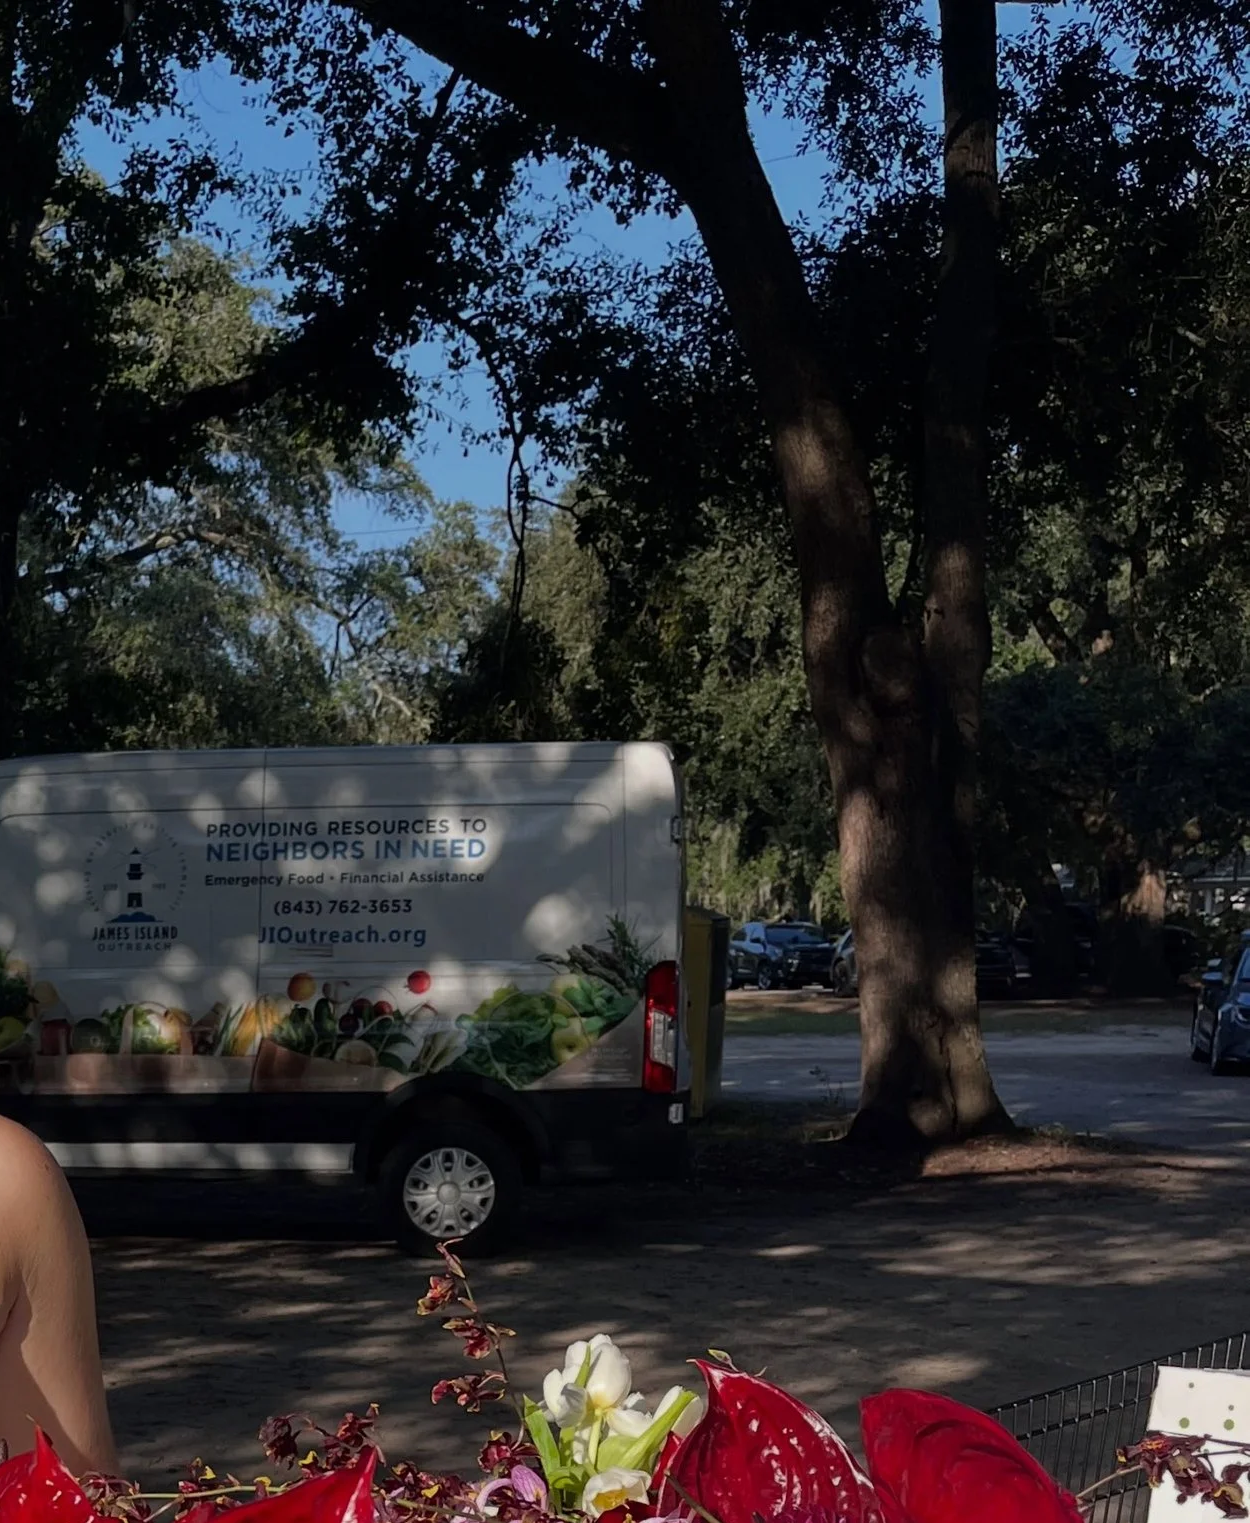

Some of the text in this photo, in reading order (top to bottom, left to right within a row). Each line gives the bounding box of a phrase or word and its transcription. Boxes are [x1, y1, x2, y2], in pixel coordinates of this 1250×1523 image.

[206, 818, 487, 838] PROVIDING RESOURCES TO
[206, 838, 486, 862] NEIGHBORS IN NEED
[205, 870, 485, 888] Emergency Food Financial Assistance
[273, 898, 413, 917] (843) 762-3653
[92, 925, 178, 941] JAMES ISLAND
[258, 925, 427, 947] JIOutreach.org
[96, 942, 172, 952] OUTREACH
